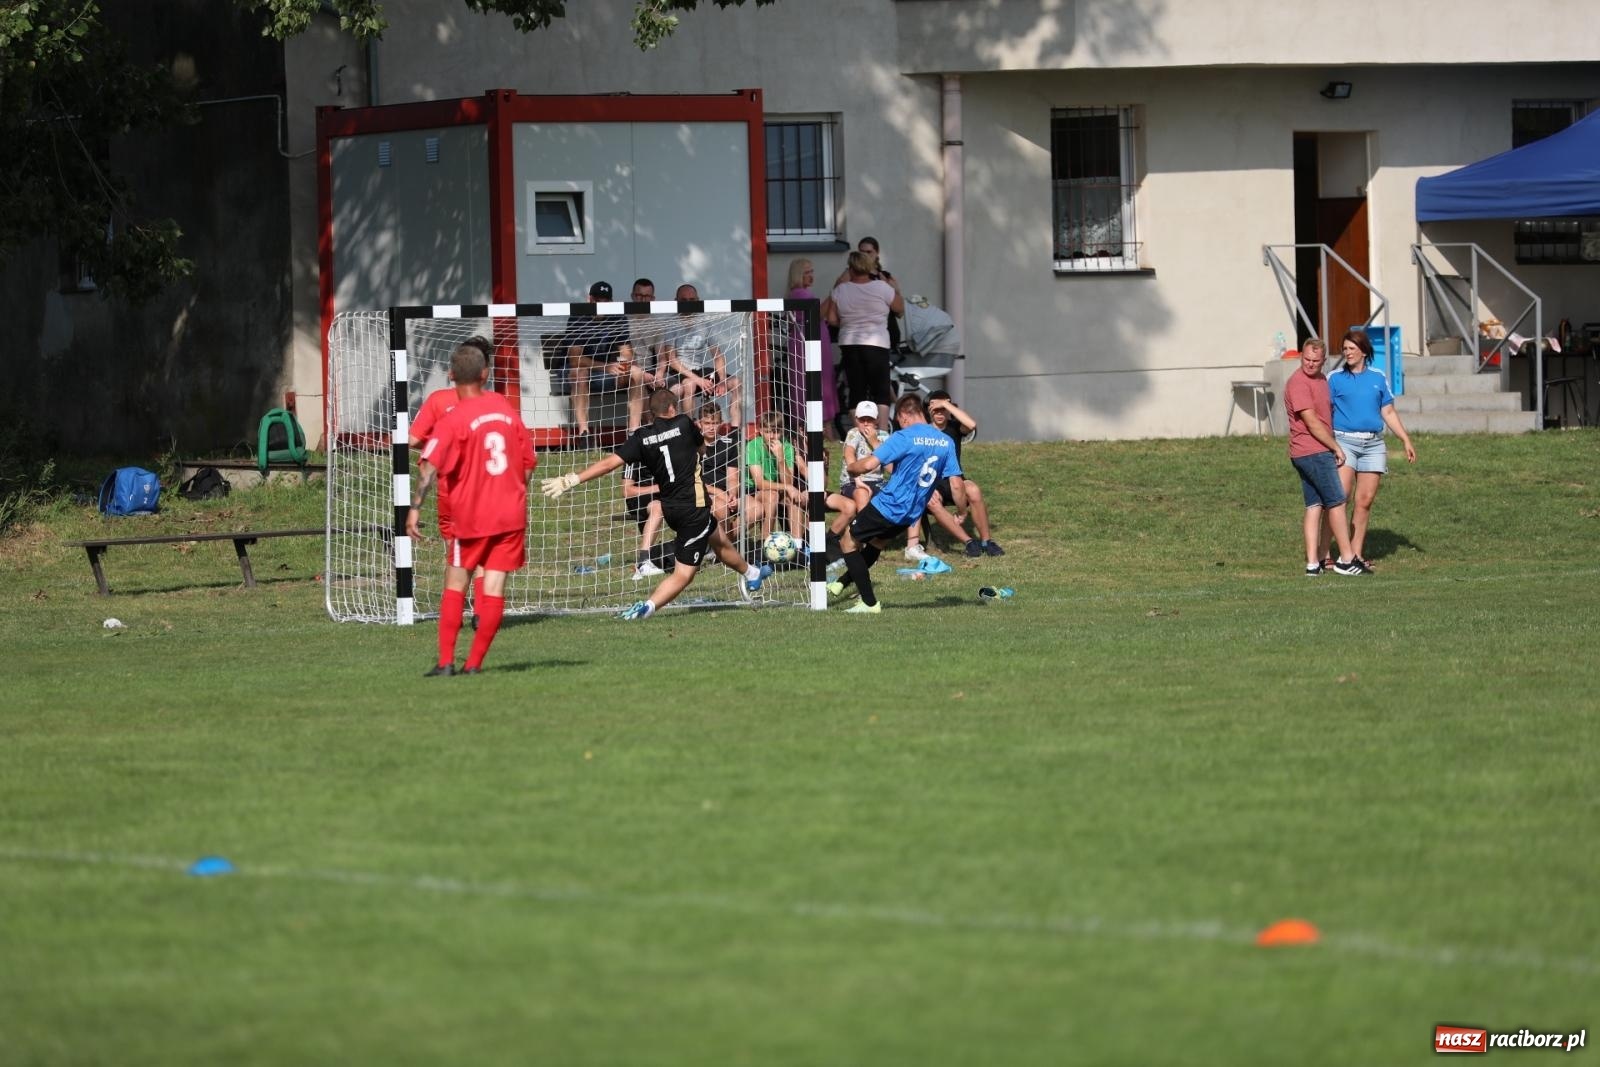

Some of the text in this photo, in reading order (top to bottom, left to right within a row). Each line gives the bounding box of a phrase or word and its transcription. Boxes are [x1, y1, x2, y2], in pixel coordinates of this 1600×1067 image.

[484, 431, 508, 475] 3
[659, 444, 675, 482] 1
[918, 455, 938, 487] 6
[694, 551, 700, 563] 9
